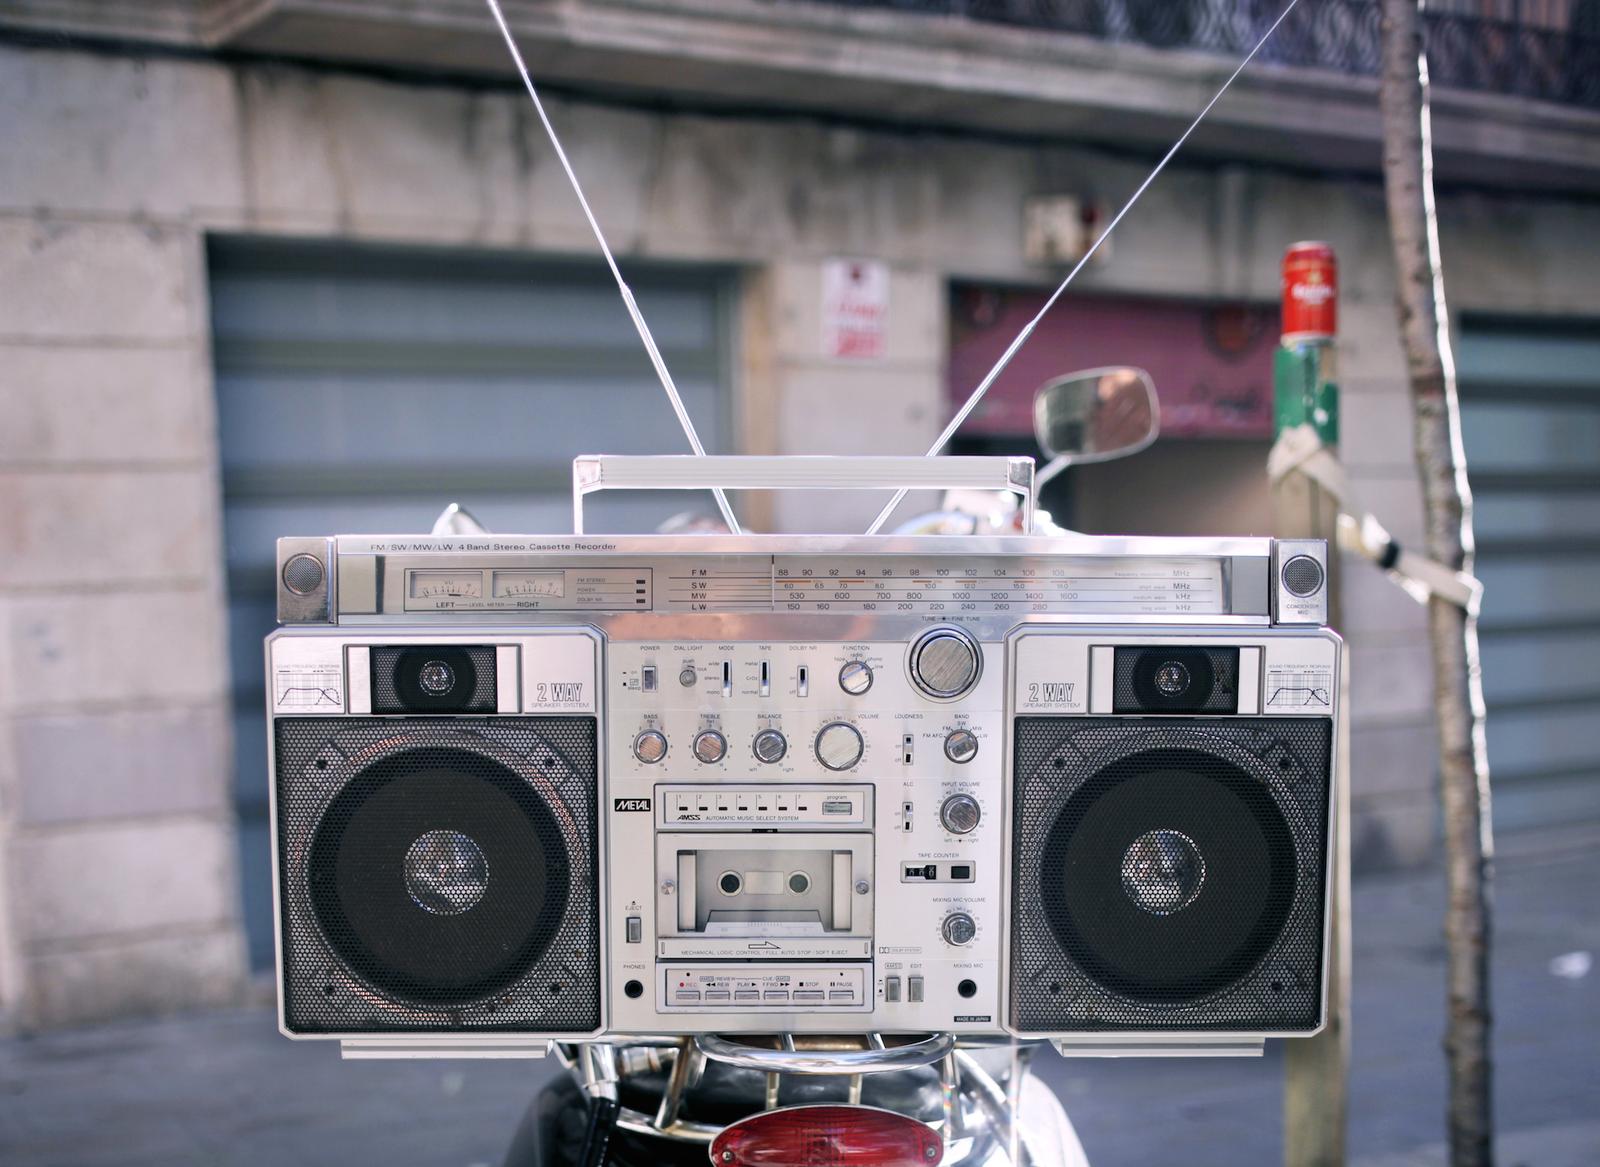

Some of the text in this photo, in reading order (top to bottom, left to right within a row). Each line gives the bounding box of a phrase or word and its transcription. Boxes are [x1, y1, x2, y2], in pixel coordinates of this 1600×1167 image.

[537, 682, 583, 702] 2 WAY
[1028, 682, 1075, 702] 2 WAY
[616, 800, 650, 810] METAL
